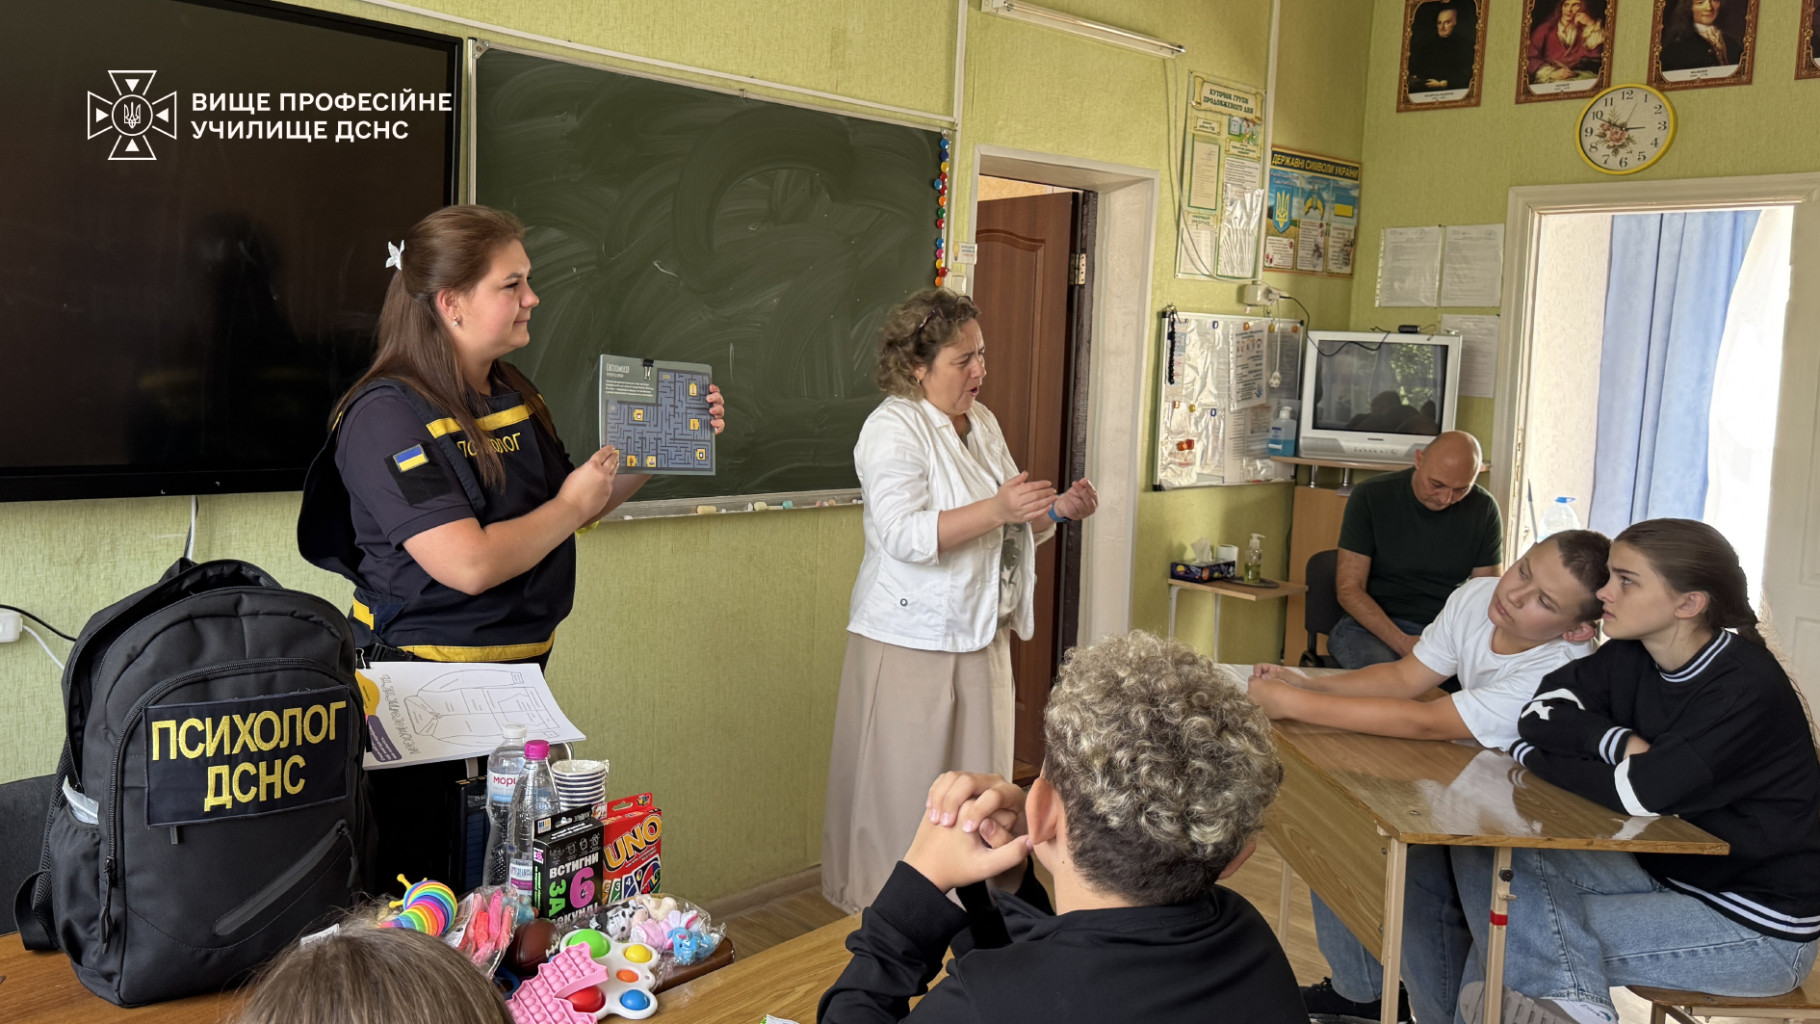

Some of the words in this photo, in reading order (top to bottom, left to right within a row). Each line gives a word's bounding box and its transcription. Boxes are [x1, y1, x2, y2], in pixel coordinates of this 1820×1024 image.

[1621, 90, 1634, 100] 12
[1644, 93, 1648, 103] 1
[1604, 97, 1613, 107] 11
[1654, 104, 1662, 115] 2
[1592, 110, 1604, 120] 10
[1657, 121, 1667, 131] 3
[1584, 127, 1594, 137] 9
[1588, 142, 1598, 152] 8
[1650, 137, 1659, 148] 4
[1602, 154, 1610, 164] 7
[1637, 151, 1646, 161] 5
[1272, 153, 1305, 170] ДЕРЖАВНІ
[1305, 159, 1335, 175] СИМВОЛИ
[1619, 157, 1628, 168] 6
[456, 432, 520, 458] ПСОЛОГ
[152, 700, 347, 761] ПСИХОЛОГ
[203, 754, 307, 812] ДСНС
[603, 814, 663, 872] UNO
[549, 852, 599, 879] ВСТИГНИ
[625, 877, 631, 886] 4
[570, 866, 596, 909] 6
[614, 883, 620, 891] 3
[549, 879, 566, 918] ЗА
